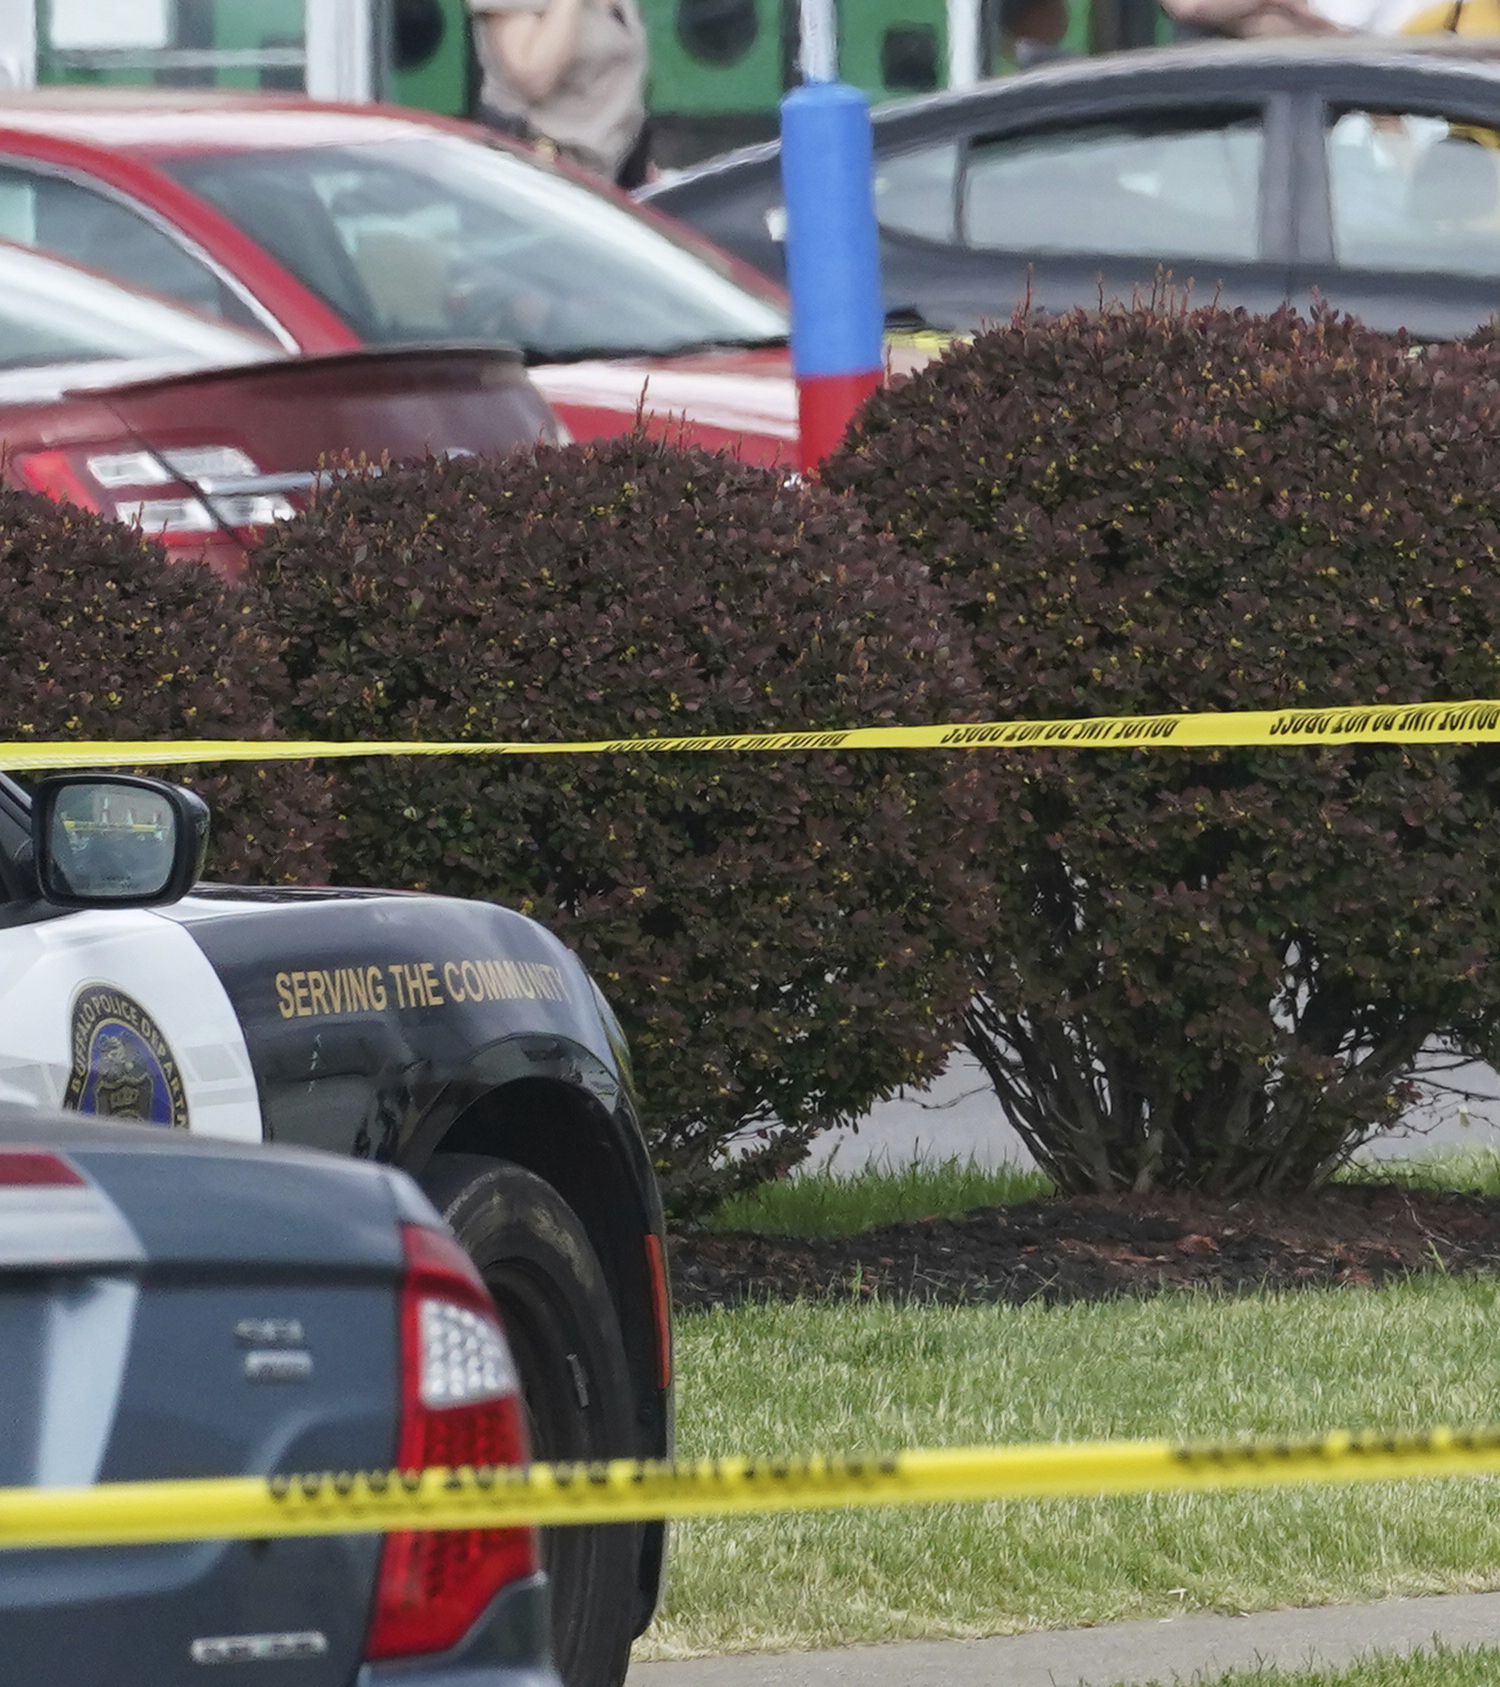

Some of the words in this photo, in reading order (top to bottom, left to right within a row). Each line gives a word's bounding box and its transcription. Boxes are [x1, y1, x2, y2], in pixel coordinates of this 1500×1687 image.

[90, 994, 139, 1025] POLICE
[275, 965, 387, 1019] SERVING
[388, 962, 444, 1009] THE
[443, 960, 573, 1005] COMMUNITY
